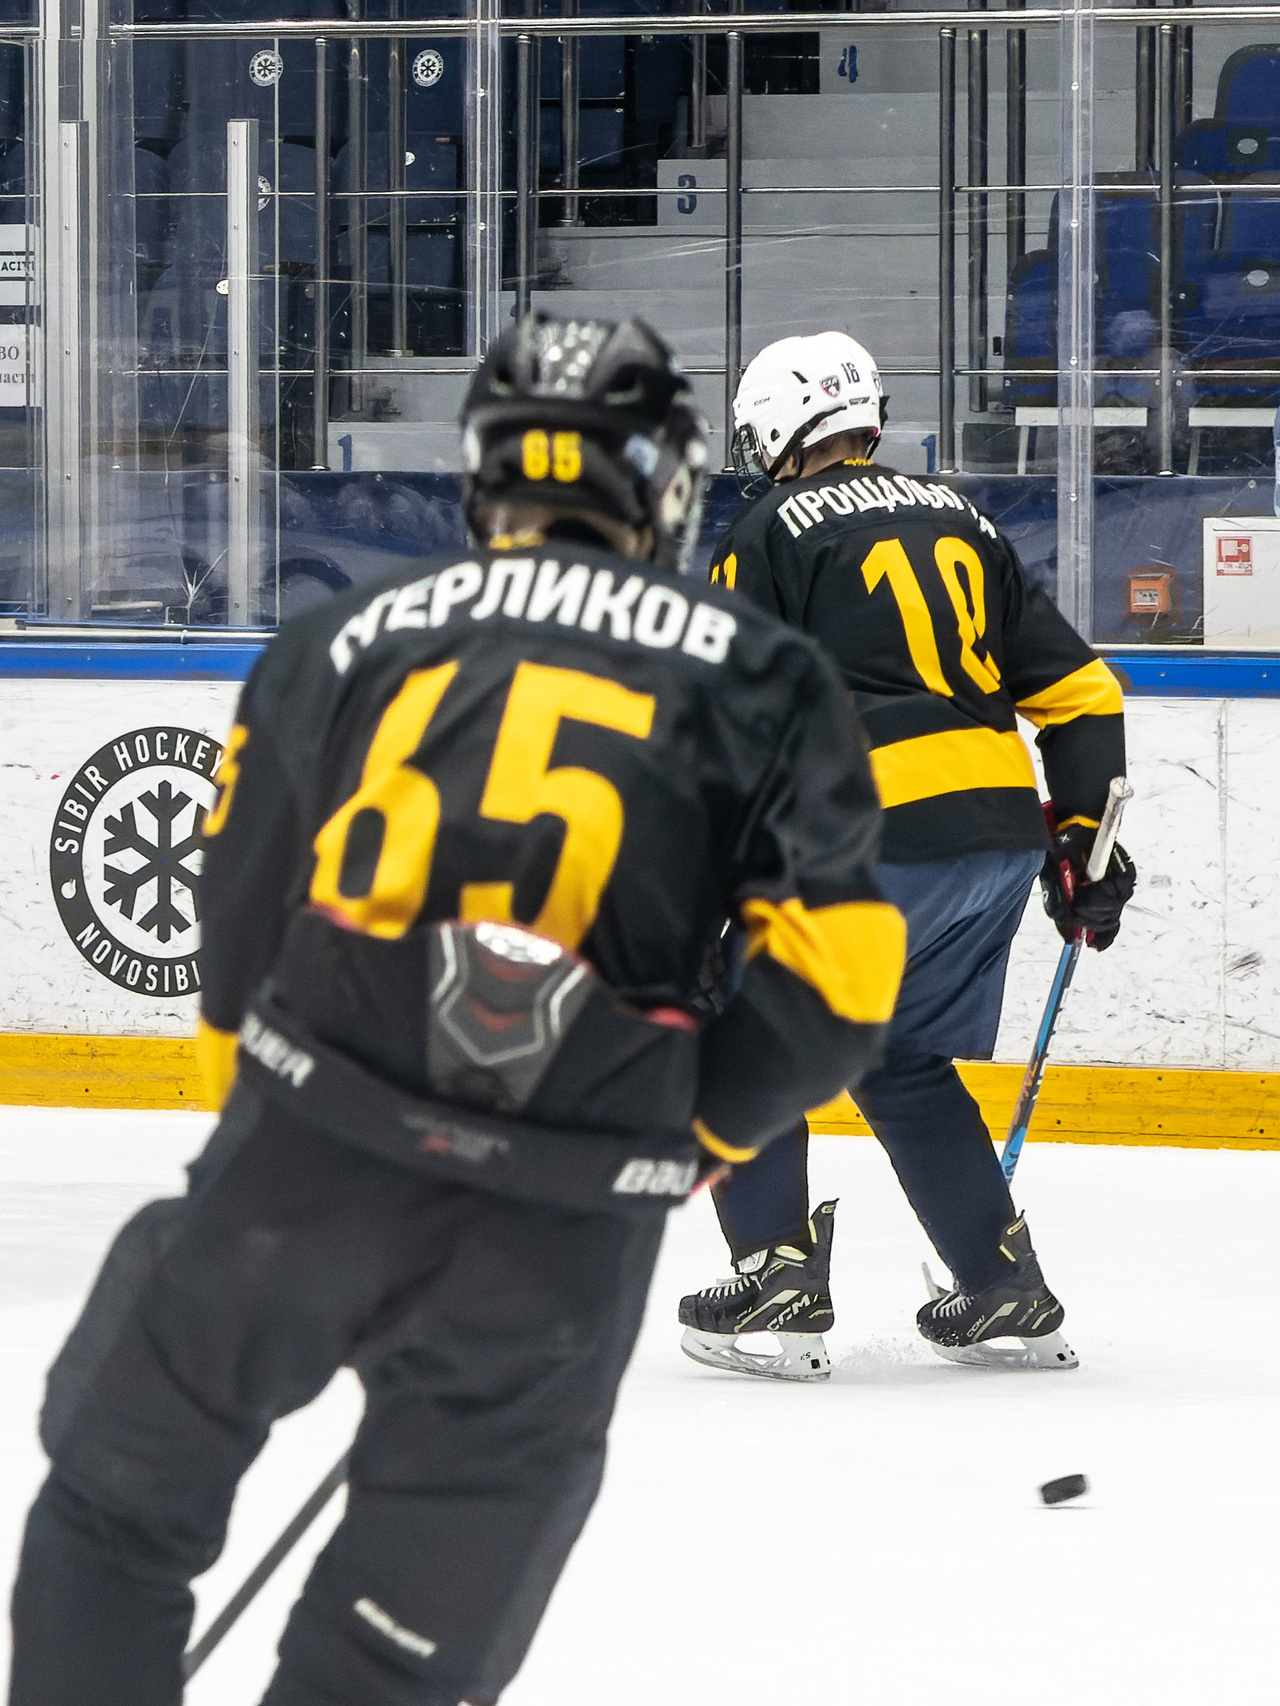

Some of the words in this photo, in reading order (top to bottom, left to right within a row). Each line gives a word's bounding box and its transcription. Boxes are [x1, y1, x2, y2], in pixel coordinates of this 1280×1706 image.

[677, 174, 697, 214] 3
[521, 428, 583, 483] 65
[55, 765, 109, 854] SIBIR
[309, 660, 656, 950] 65
